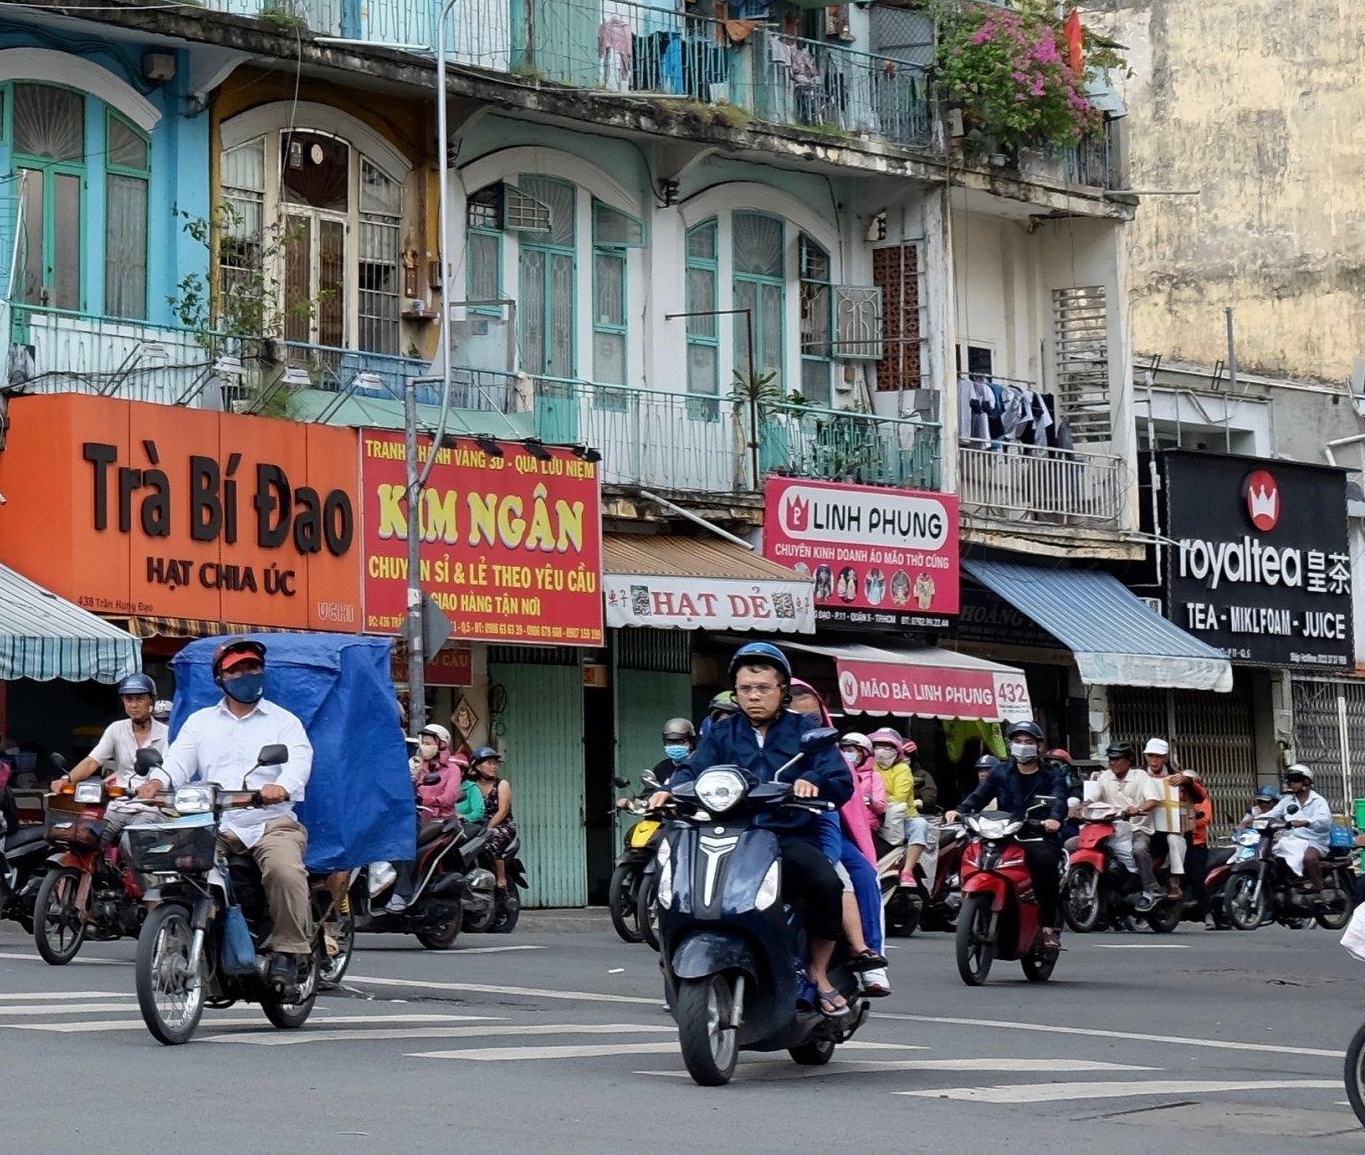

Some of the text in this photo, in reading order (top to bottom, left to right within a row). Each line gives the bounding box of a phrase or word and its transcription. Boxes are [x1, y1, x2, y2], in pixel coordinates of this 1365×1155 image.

[365, 440, 405, 461] TRANH
[82, 440, 354, 557] Trà Bí Đao
[467, 482, 585, 553] NGÂN
[813, 502, 943, 543] LINH PHỤNG
[775, 543, 811, 558] CHUYÊN
[813, 547, 835, 560] KINH
[836, 548, 868, 562] DOANH
[869, 550, 882, 563] ÁO
[1180, 535, 1302, 589] royaltea
[1306, 549, 1351, 594] 皇茶
[146, 557, 296, 597] HẠT CHIA ÚC
[453, 562, 465, 584] &
[469, 556, 488, 586] LẺ
[492, 565, 531, 588] THEO
[535, 563, 564, 591] YÊU
[568, 561, 596, 593] CẦU
[460, 590, 492, 613] HÀNG
[495, 594, 517, 617] TẬN
[651, 586, 771, 622] HẠT DẺ
[1187, 602, 1219, 630] TEA
[1303, 611, 1346, 639] JUICE
[860, 678, 890, 699] MÃO
[892, 680, 911, 700] BÀ
[914, 684, 942, 702] LINH
[998, 683, 1027, 703] 432
